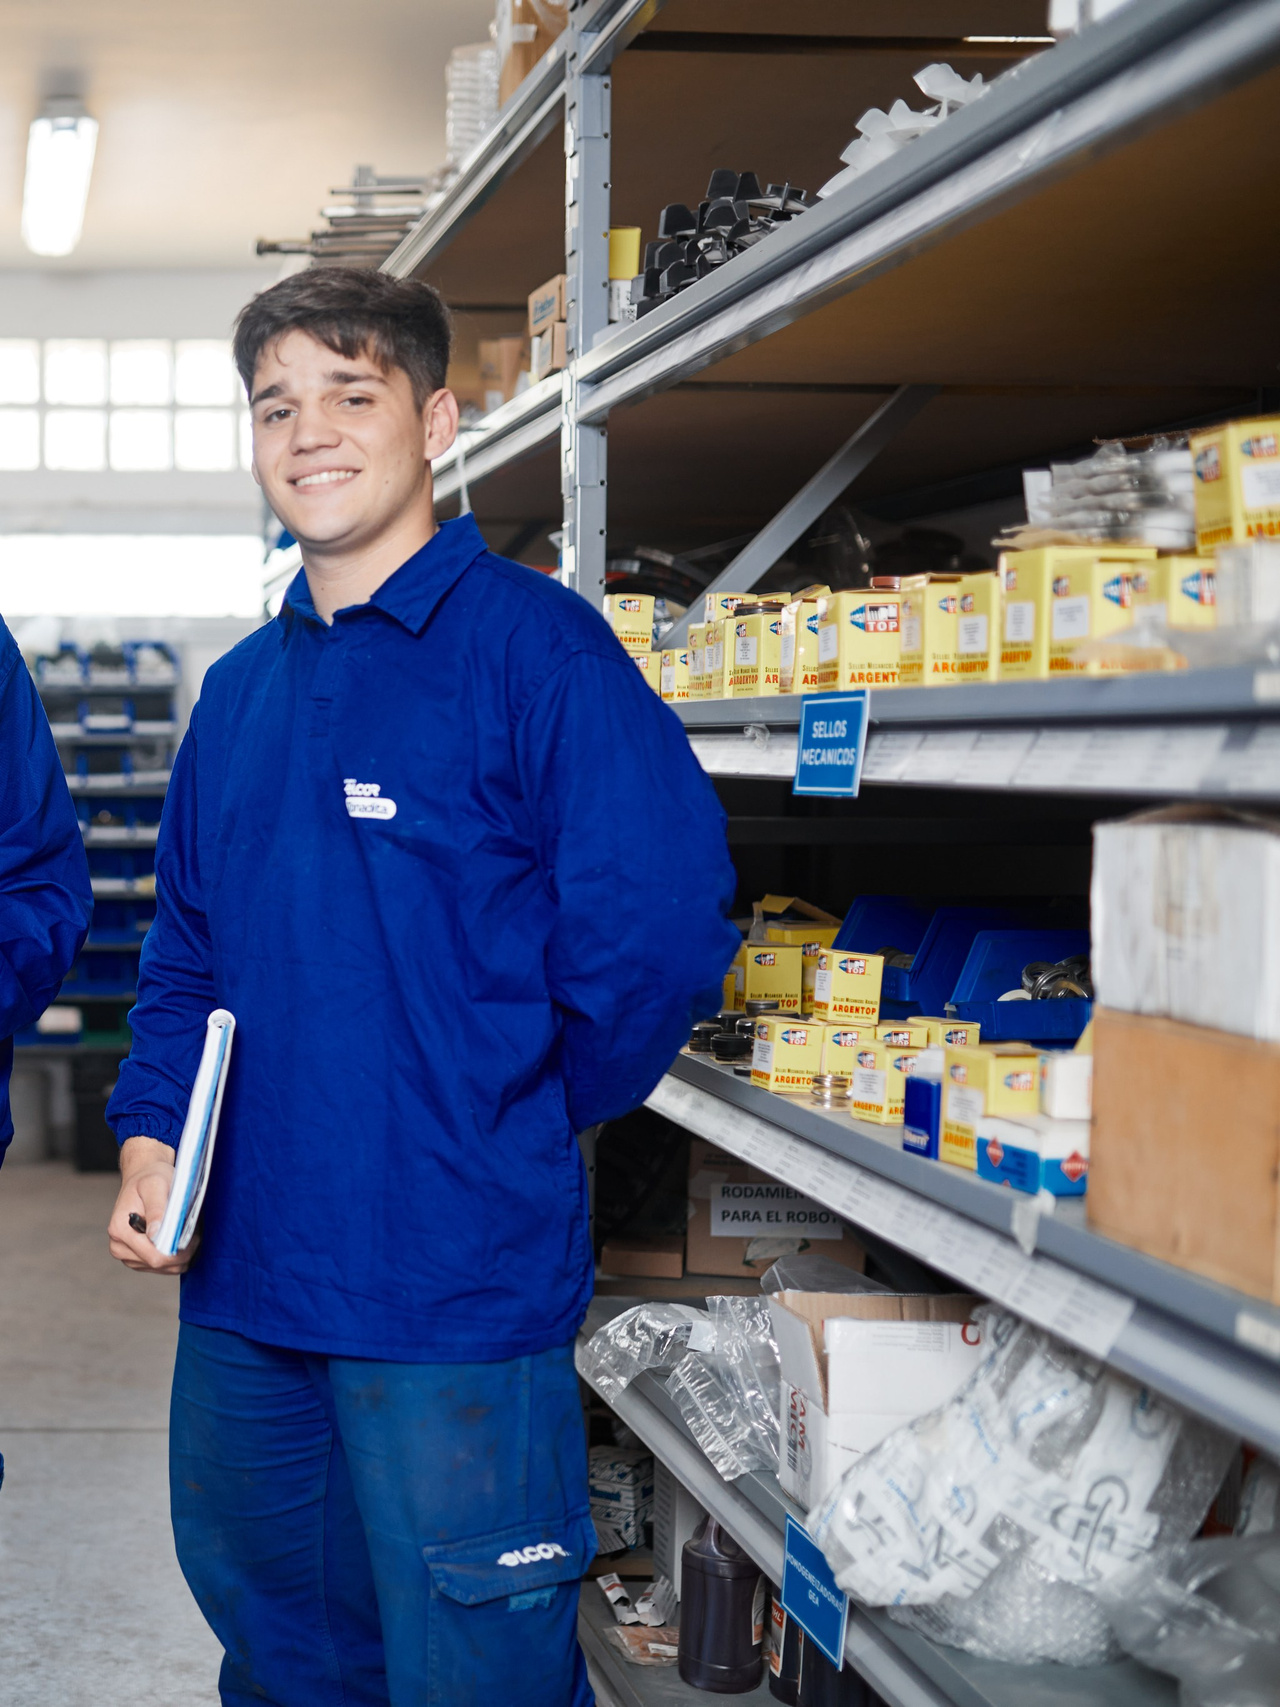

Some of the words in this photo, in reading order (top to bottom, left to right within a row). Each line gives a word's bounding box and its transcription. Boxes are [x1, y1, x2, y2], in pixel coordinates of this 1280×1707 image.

[867, 621, 898, 631] TOP
[849, 672, 898, 683] ARGENT
[812, 719, 847, 738] SELLOS
[802, 748, 856, 766] MECANICOS
[832, 1004, 877, 1015] ARGENTOP
[775, 1074, 814, 1085] ARGENTO
[853, 1101, 883, 1114] ARGENTOP
[722, 1186, 805, 1199] RODAMIEN
[722, 1210, 762, 1223] PARA
[766, 1211, 783, 1223] EL
[808, 1589, 819, 1607] GEA
